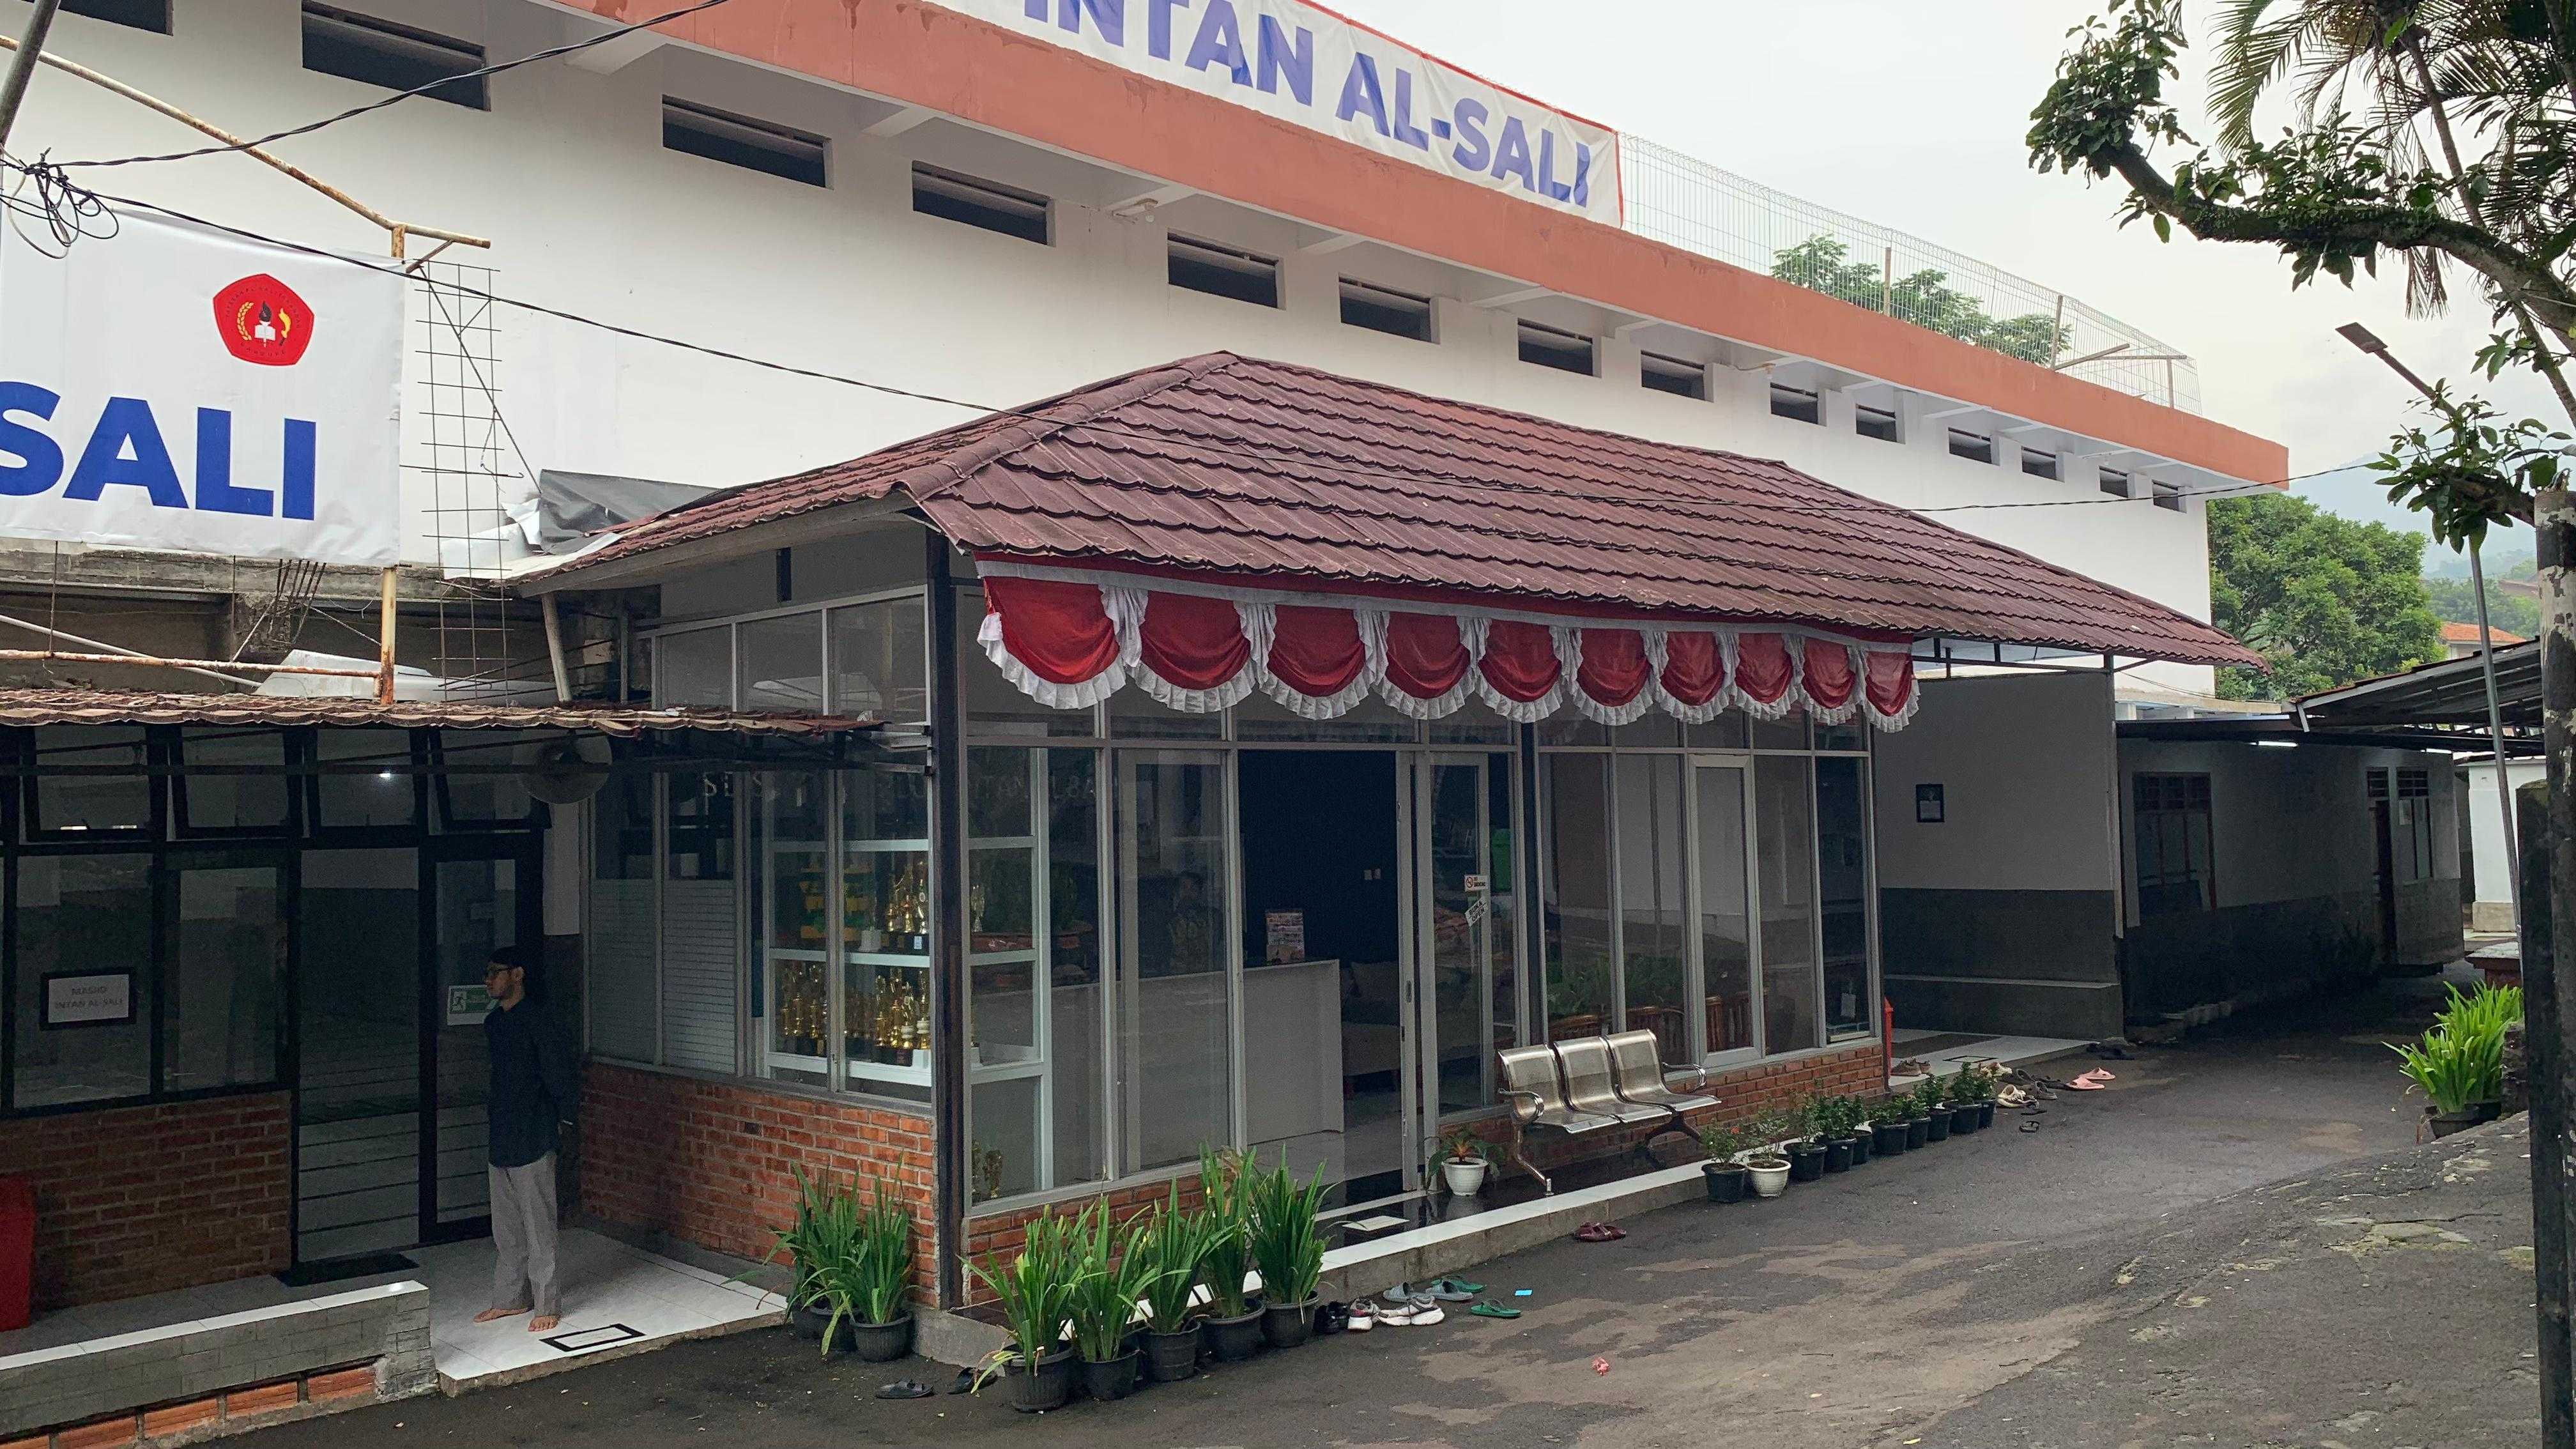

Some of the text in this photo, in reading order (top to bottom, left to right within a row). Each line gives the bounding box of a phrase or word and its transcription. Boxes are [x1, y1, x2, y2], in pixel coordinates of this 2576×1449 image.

[1024, 0, 1590, 208] NTAN AL-SALI
[0, 381, 316, 521] SALI
[1472, 908, 1485, 921] OPEN
